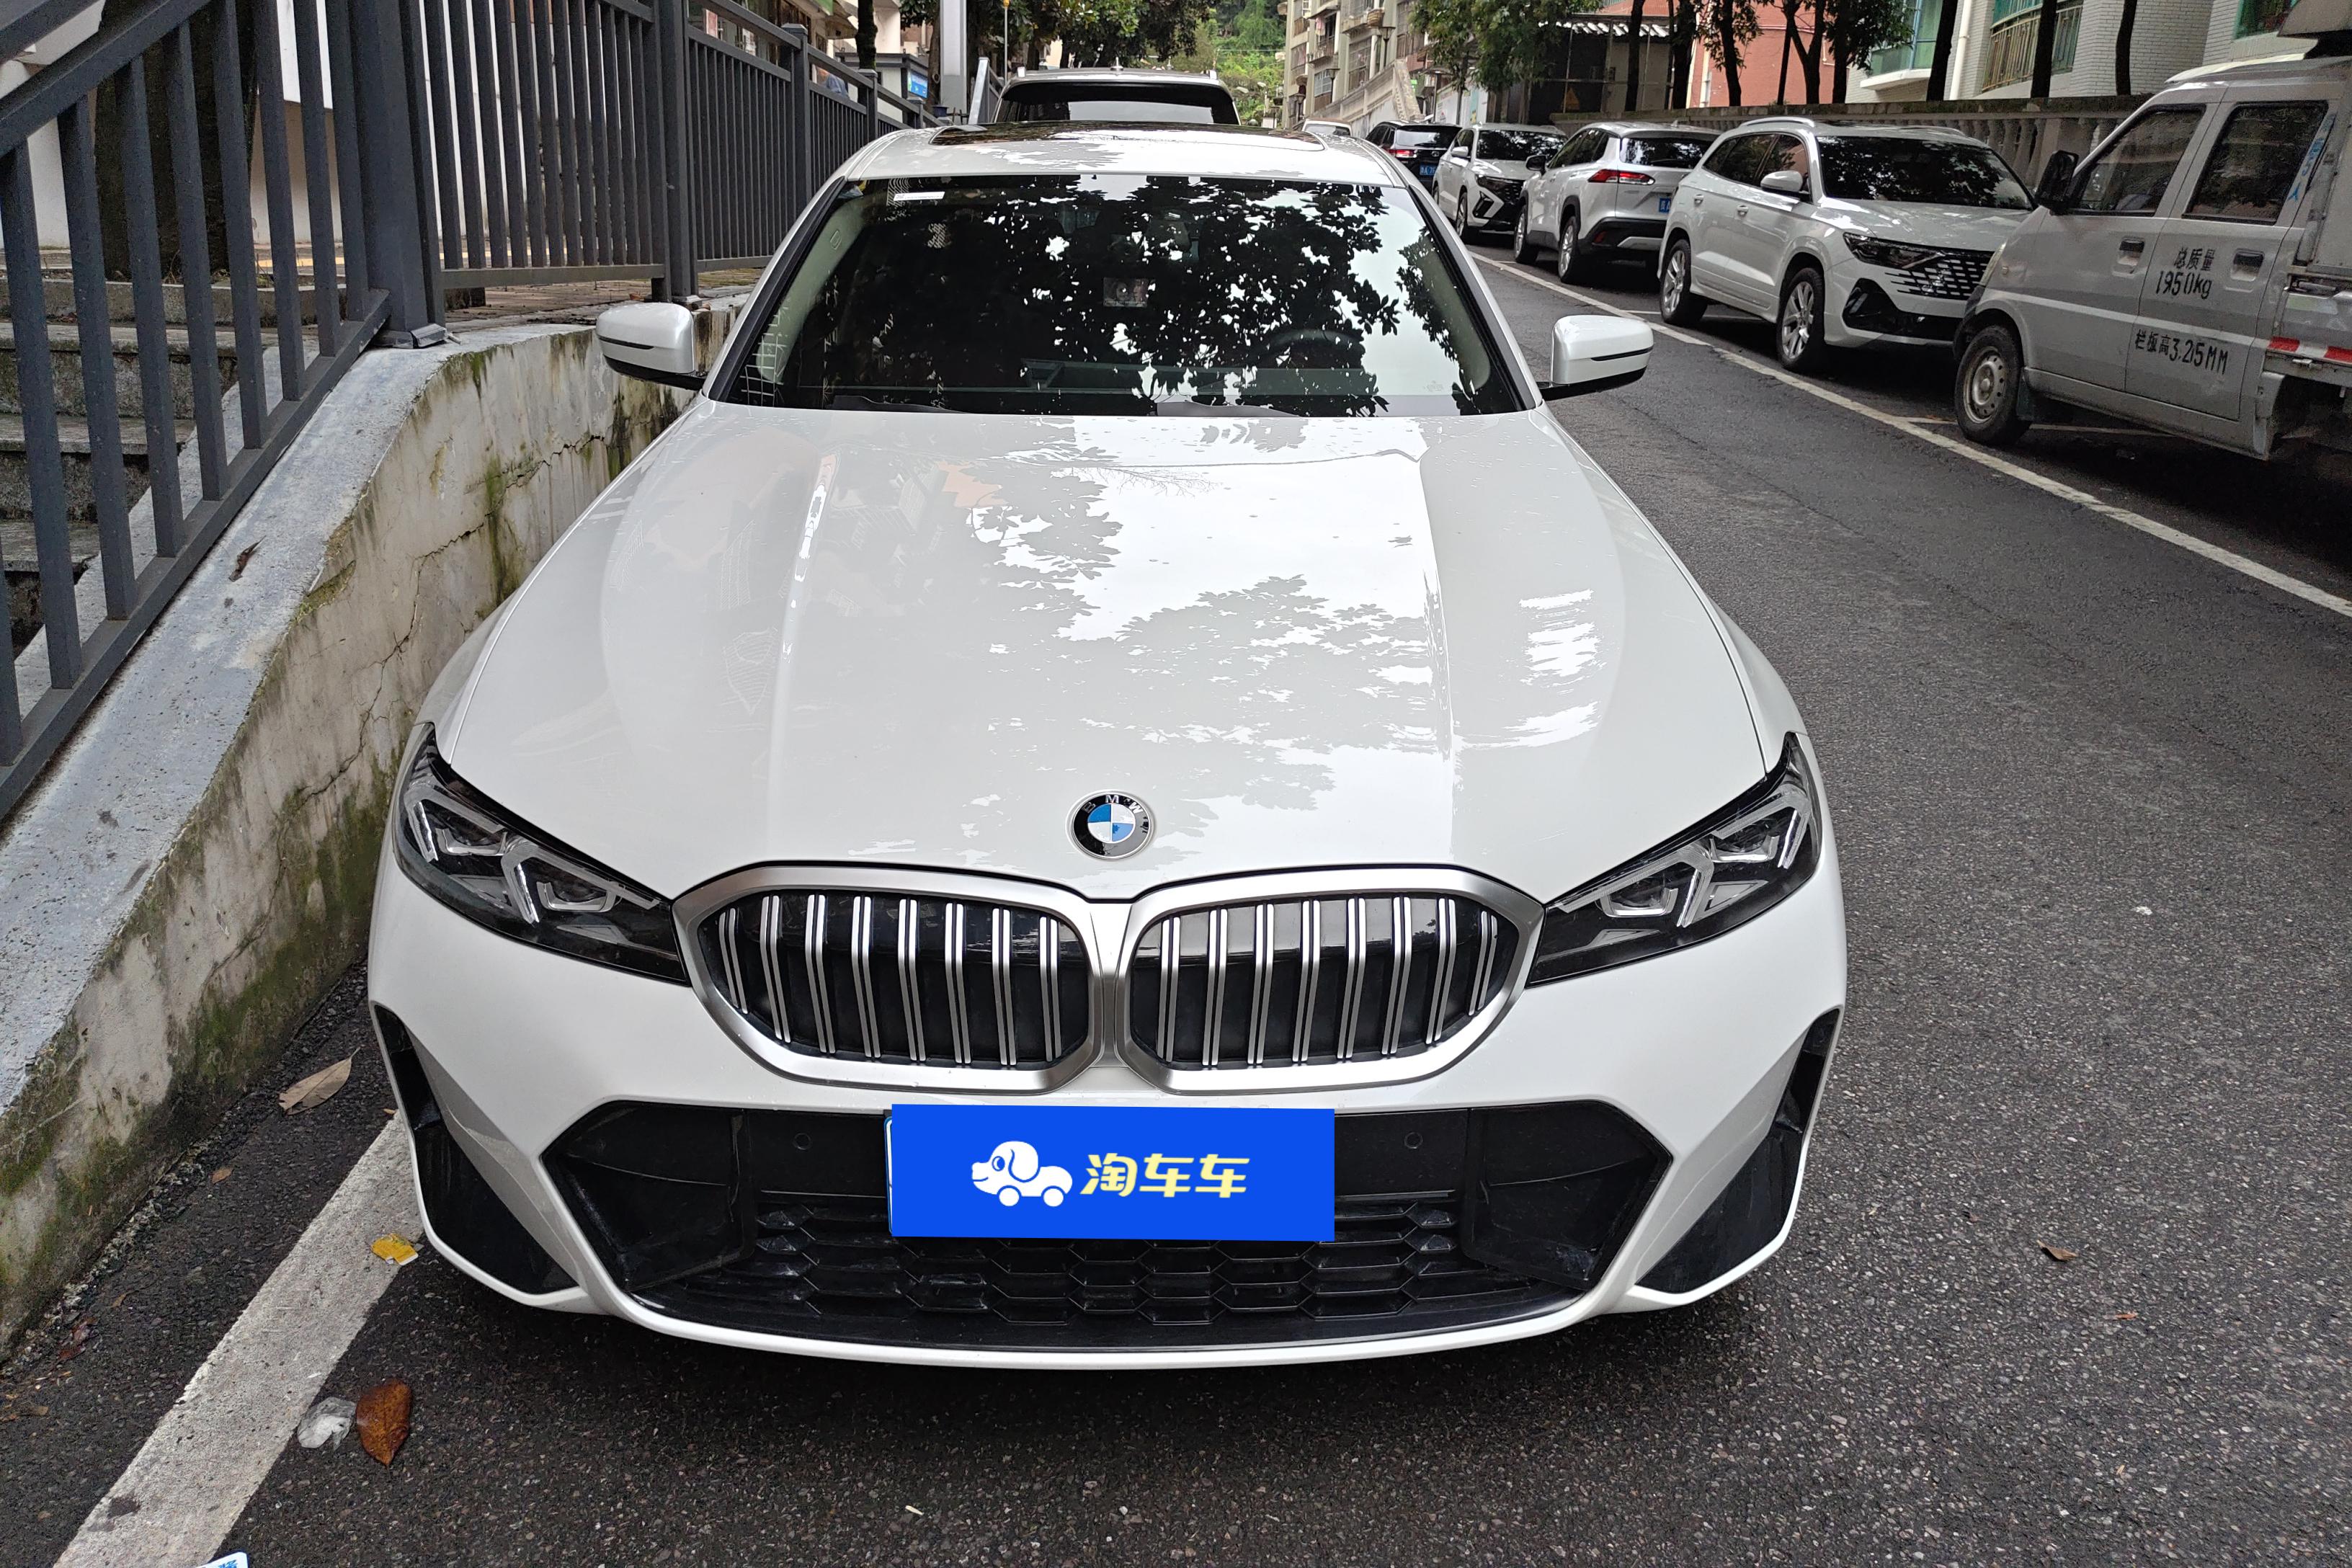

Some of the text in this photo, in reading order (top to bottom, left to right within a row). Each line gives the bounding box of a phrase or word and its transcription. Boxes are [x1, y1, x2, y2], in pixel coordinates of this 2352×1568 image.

[2174, 248, 2215, 271] 总质量
[1083, 795, 1143, 814] BMW
